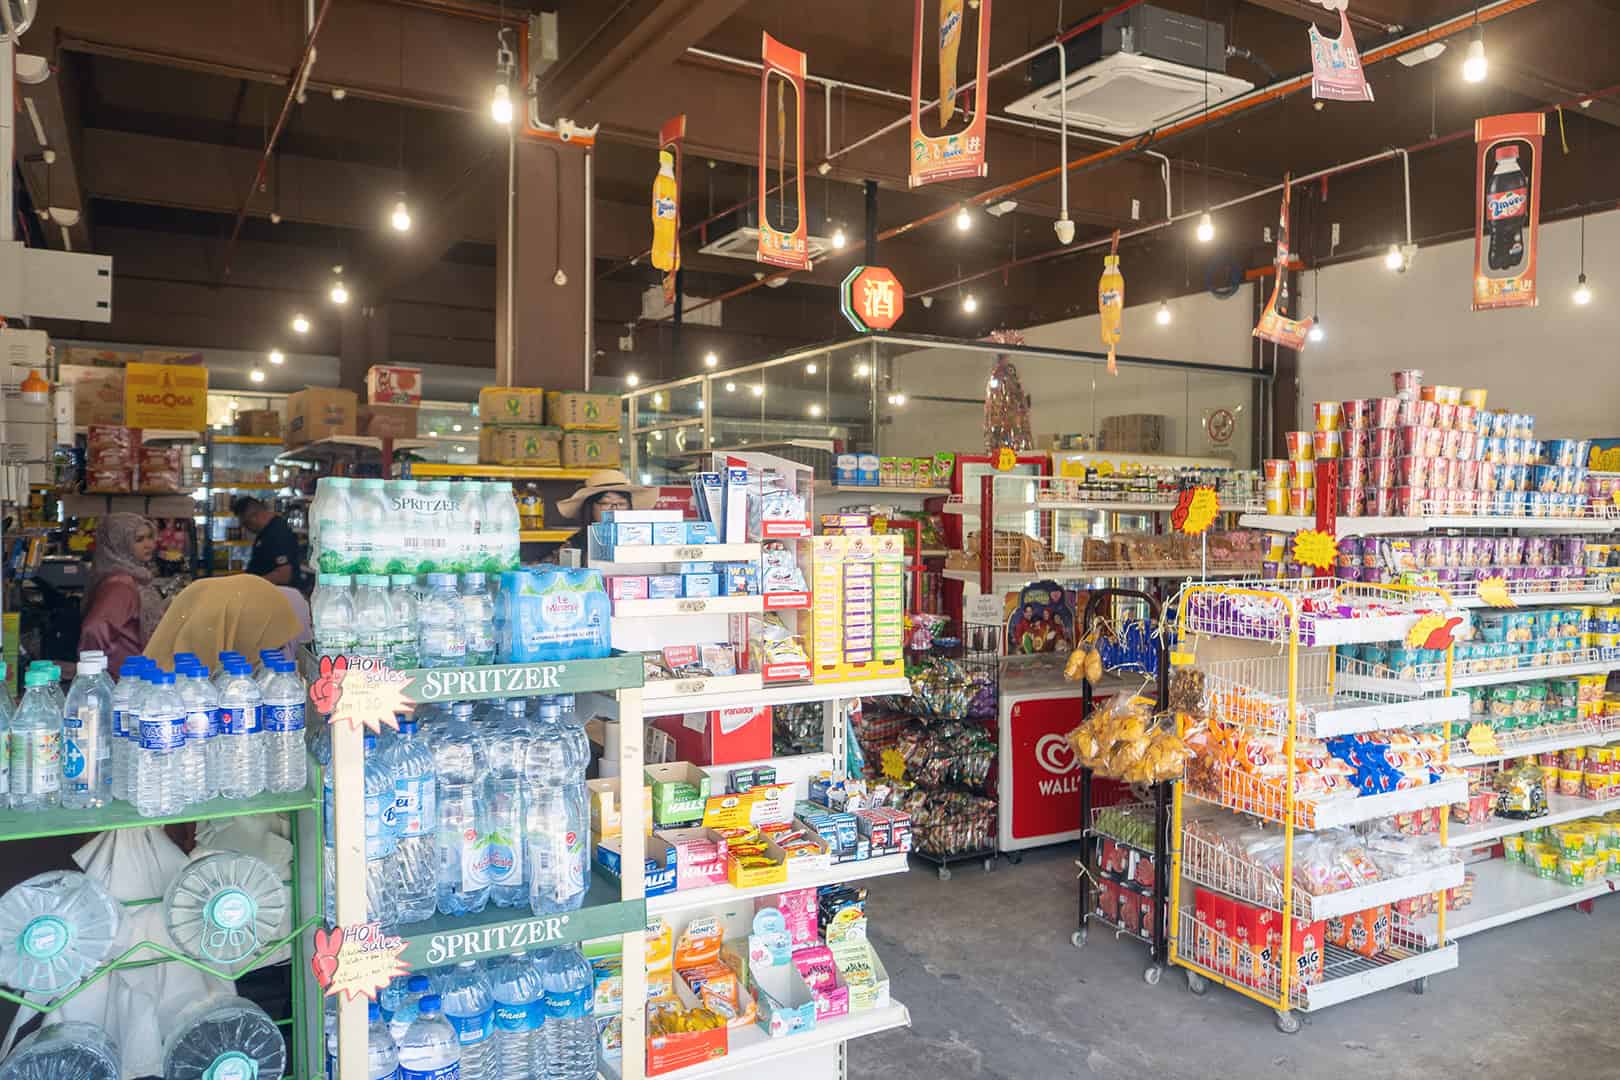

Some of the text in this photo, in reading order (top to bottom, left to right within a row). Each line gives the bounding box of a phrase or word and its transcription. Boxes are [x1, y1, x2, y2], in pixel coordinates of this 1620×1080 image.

[864, 279, 895, 319] 酒
[391, 496, 460, 512] SPRITZER
[348, 656, 385, 671] HOT
[422, 669, 560, 699] SPRITZER
[1038, 775, 1081, 797] WALL'
[344, 926, 380, 943] HOT
[362, 934, 402, 952] sales
[426, 919, 564, 964] SPRITZER
[1297, 951, 1319, 968] BIG
